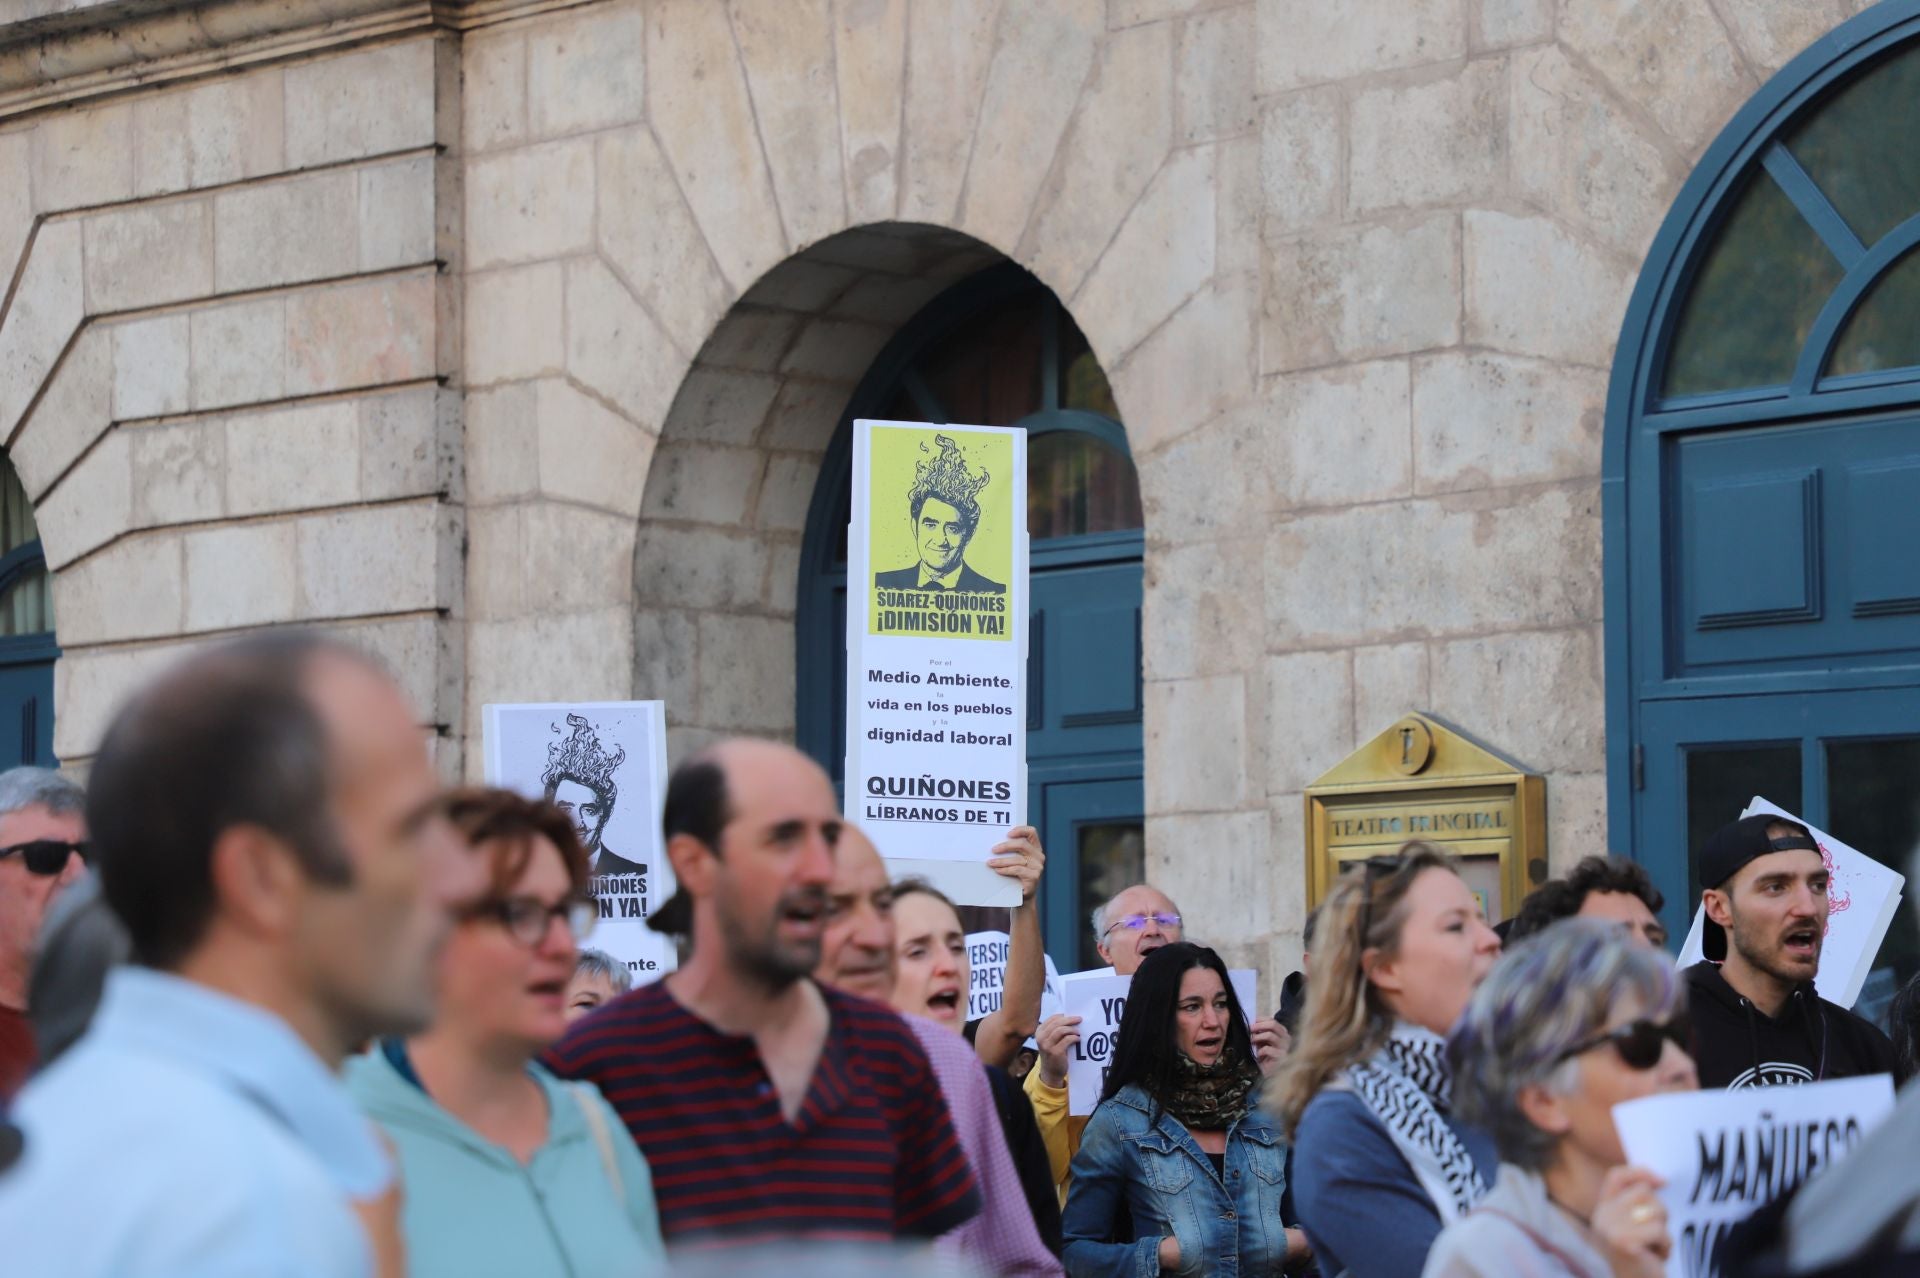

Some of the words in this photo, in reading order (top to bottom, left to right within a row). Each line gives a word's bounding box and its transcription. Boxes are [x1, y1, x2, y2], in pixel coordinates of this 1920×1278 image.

[877, 591, 1006, 612] SUAREZ-QUIÑONES
[877, 611, 972, 634] ¡DIMISIÓN
[977, 615, 1005, 635] YA!
[868, 670, 921, 684] Medio
[927, 672, 1013, 689] Ambiente,
[868, 699, 899, 710] vida
[904, 701, 922, 711] en
[927, 701, 949, 712] los
[954, 704, 1013, 715] pueblos
[867, 728, 944, 744] dignidad
[950, 731, 1012, 746] laboral
[867, 774, 1011, 801] QUIÑONES
[866, 803, 958, 822] LÍBRANOS
[965, 810, 987, 823] DE
[994, 811, 1010, 824] TI
[1332, 817, 1403, 837] TEATRO
[1409, 811, 1507, 833] PRINCIPAL
[618, 897, 647, 917] YA!
